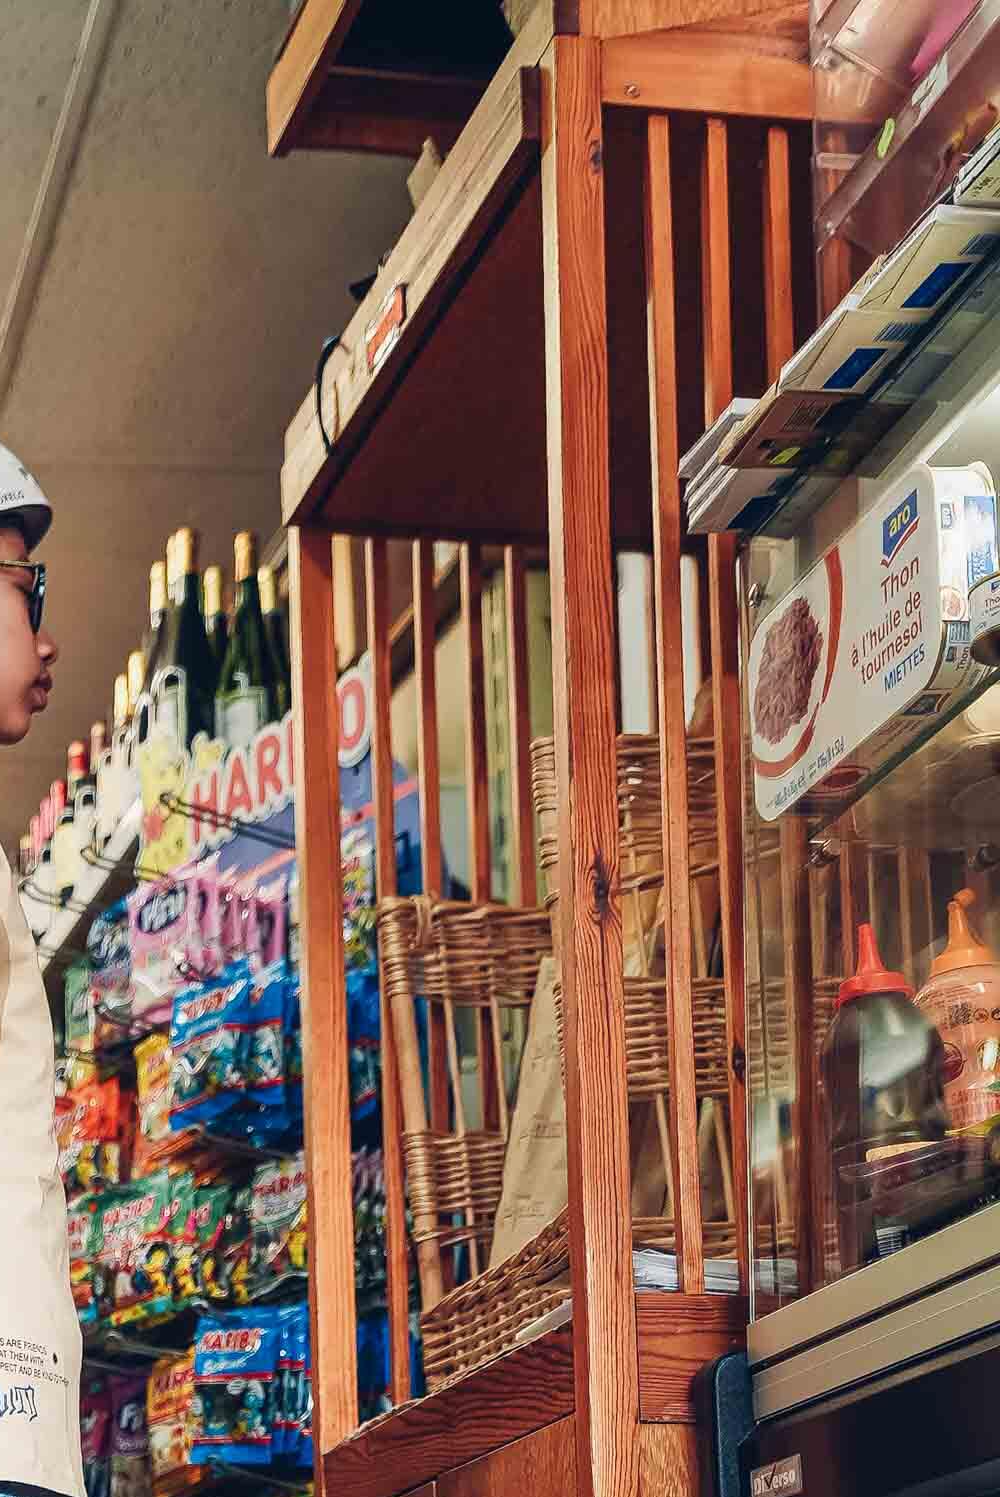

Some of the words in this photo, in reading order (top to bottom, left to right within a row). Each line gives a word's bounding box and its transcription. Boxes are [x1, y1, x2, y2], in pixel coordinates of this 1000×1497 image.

[889, 506, 910, 537] aro
[881, 556, 920, 603] Thon
[861, 607, 901, 655] l'huile
[905, 591, 921, 615] de
[861, 611, 922, 686] tournesol
[884, 643, 926, 693] MIETTES
[188, 677, 366, 842] HARIO
[6, 1338, 22, 1349] ARE
[9, 1350, 29, 1362] THEM
[19, 1366, 32, 1377] AND
